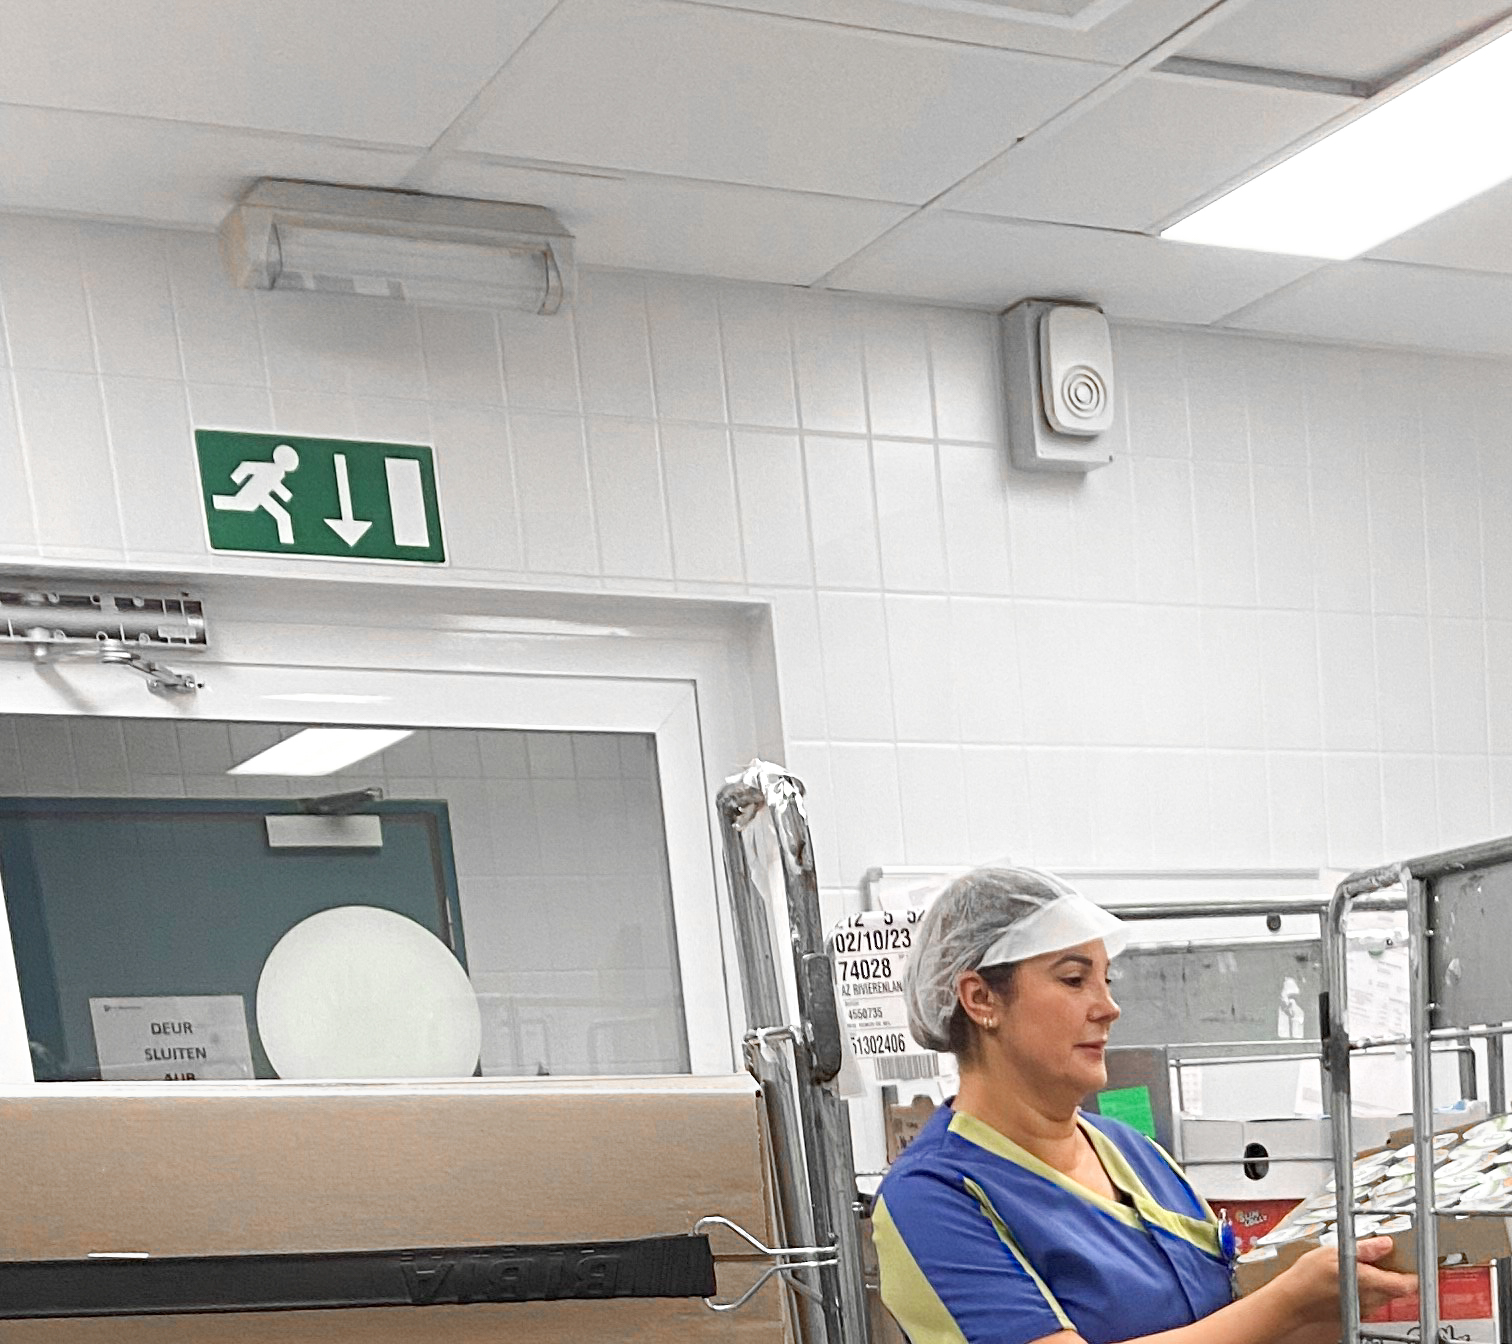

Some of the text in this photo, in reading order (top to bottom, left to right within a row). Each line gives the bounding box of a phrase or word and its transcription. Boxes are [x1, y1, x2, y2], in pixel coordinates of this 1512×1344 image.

[835, 928, 912, 953] 02/10/23
[838, 958, 892, 981] 74028
[151, 1022, 193, 1035] DEUR
[145, 1047, 207, 1062] SLUITEN
